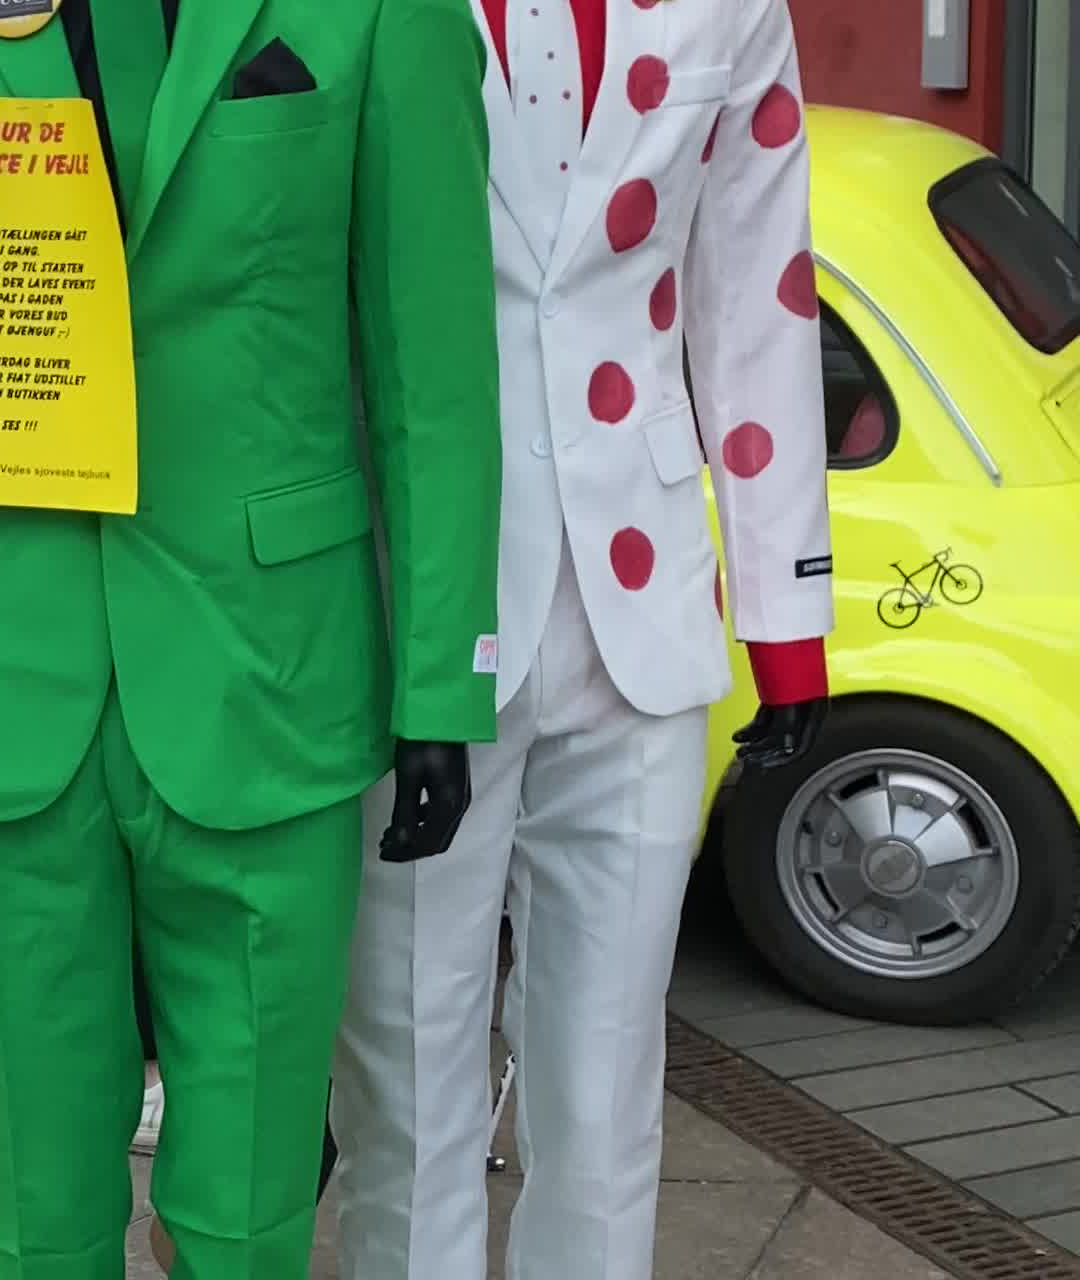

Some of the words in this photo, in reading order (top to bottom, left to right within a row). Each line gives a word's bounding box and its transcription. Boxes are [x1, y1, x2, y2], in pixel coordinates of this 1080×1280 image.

[39, 122, 65, 143] DE
[27, 154, 38, 174] I
[45, 154, 89, 175] VEJLE
[64, 228, 88, 241] GÅET
[3, 261, 19, 272] OP
[22, 262, 37, 273] TIL
[40, 262, 84, 273] STARTEN
[2, 277, 25, 288] DER
[28, 278, 60, 289] LAVES
[62, 279, 96, 290] EVENTS
[27, 294, 64, 305] GADEN
[9, 310, 43, 320] VORES
[46, 310, 68, 321] BUD
[34, 357, 71, 370] BLIVER
[6, 372, 32, 383] FIAT
[34, 373, 86, 386] UDSTILLET
[6, 388, 61, 400] BUTIKKEN
[2, 420, 21, 431] SES
